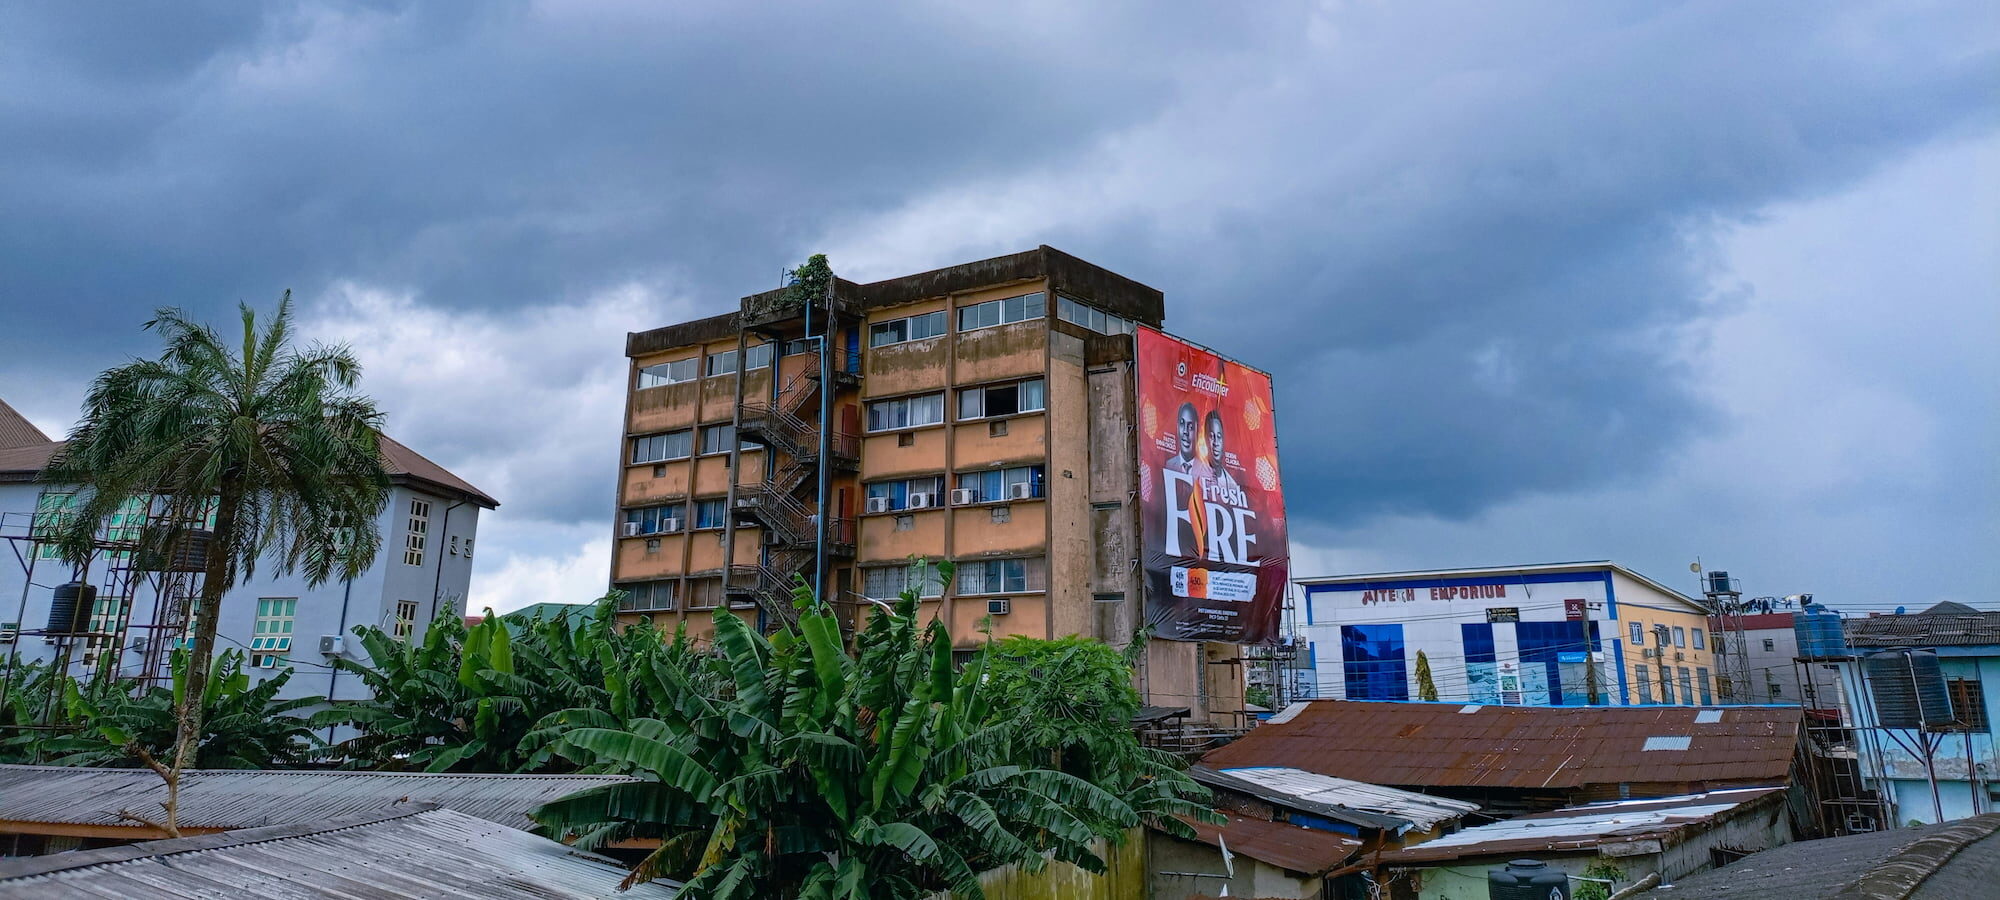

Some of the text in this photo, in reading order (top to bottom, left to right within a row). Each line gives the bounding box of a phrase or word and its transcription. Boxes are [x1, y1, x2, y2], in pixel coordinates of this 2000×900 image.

[1191, 374, 1229, 397] Encounter
[1201, 477, 1248, 508] Fresh
[1430, 584, 1506, 601] EMPORIUM
